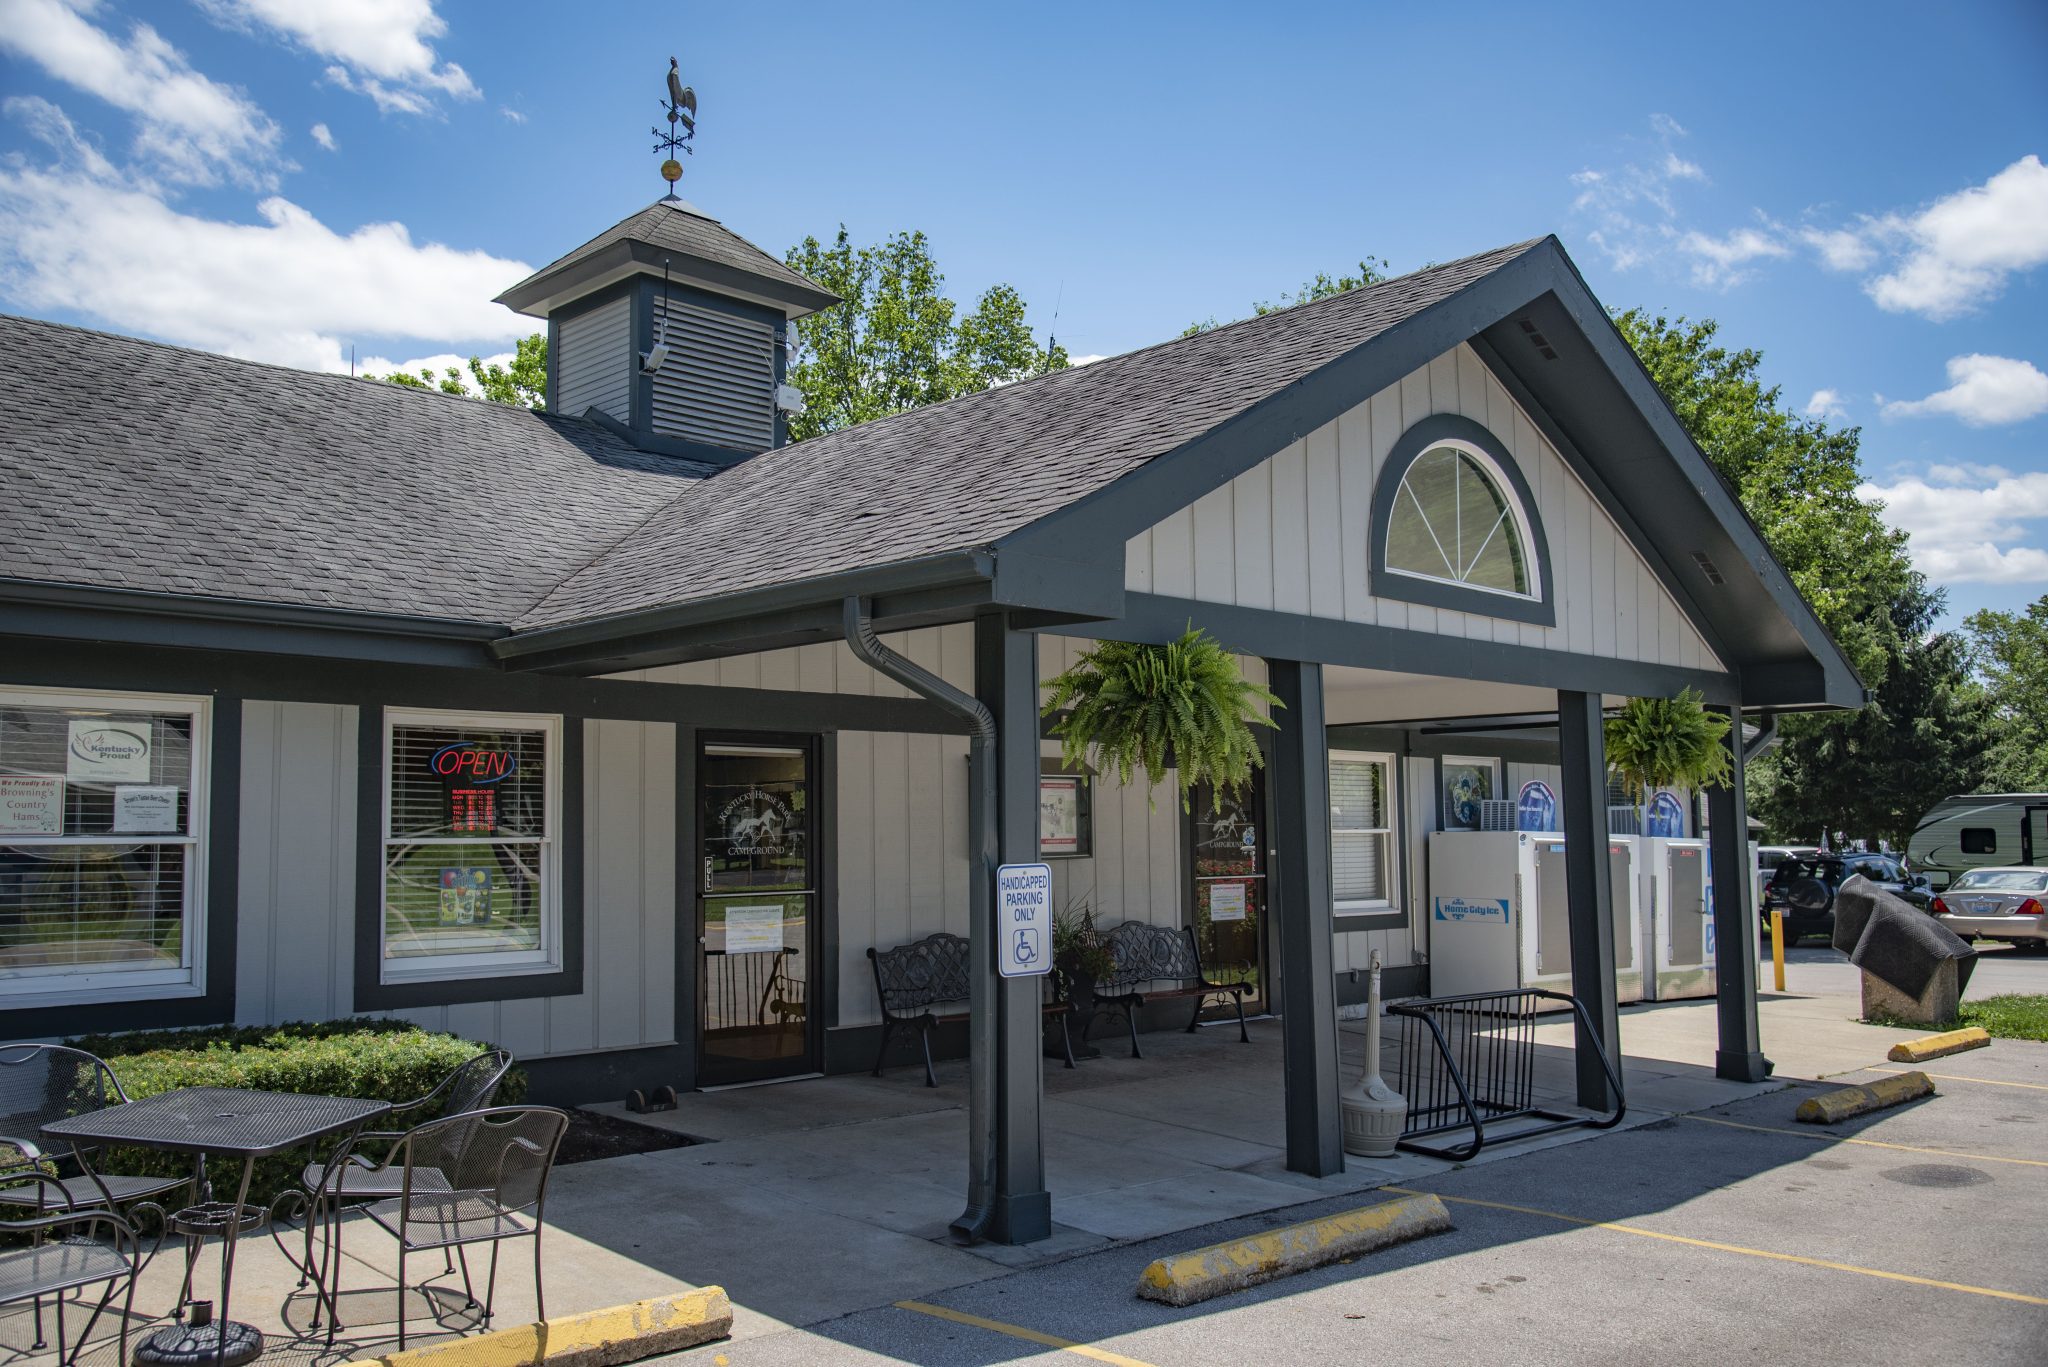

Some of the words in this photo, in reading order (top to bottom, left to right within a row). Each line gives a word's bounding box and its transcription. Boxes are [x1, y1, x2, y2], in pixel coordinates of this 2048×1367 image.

[91, 745, 140, 754] Kentucky
[438, 751, 509, 776] OPEN
[1, 788, 55, 799] Browning's
[7, 800, 48, 812] Country
[719, 792, 753, 822] KENTUCKY
[755, 790, 778, 805] HORSE
[777, 801, 792, 823] PARK
[13, 812, 40, 821] Hams
[728, 846, 785, 855] CAMPGROUND
[1001, 875, 1048, 891] HANDICAPPED
[1006, 892, 1043, 906] PARKING
[1014, 908, 1036, 922] ONLY
[1444, 904, 1469, 913] Home
[1469, 905, 1486, 915] City
[1486, 906, 1500, 914] Ice
